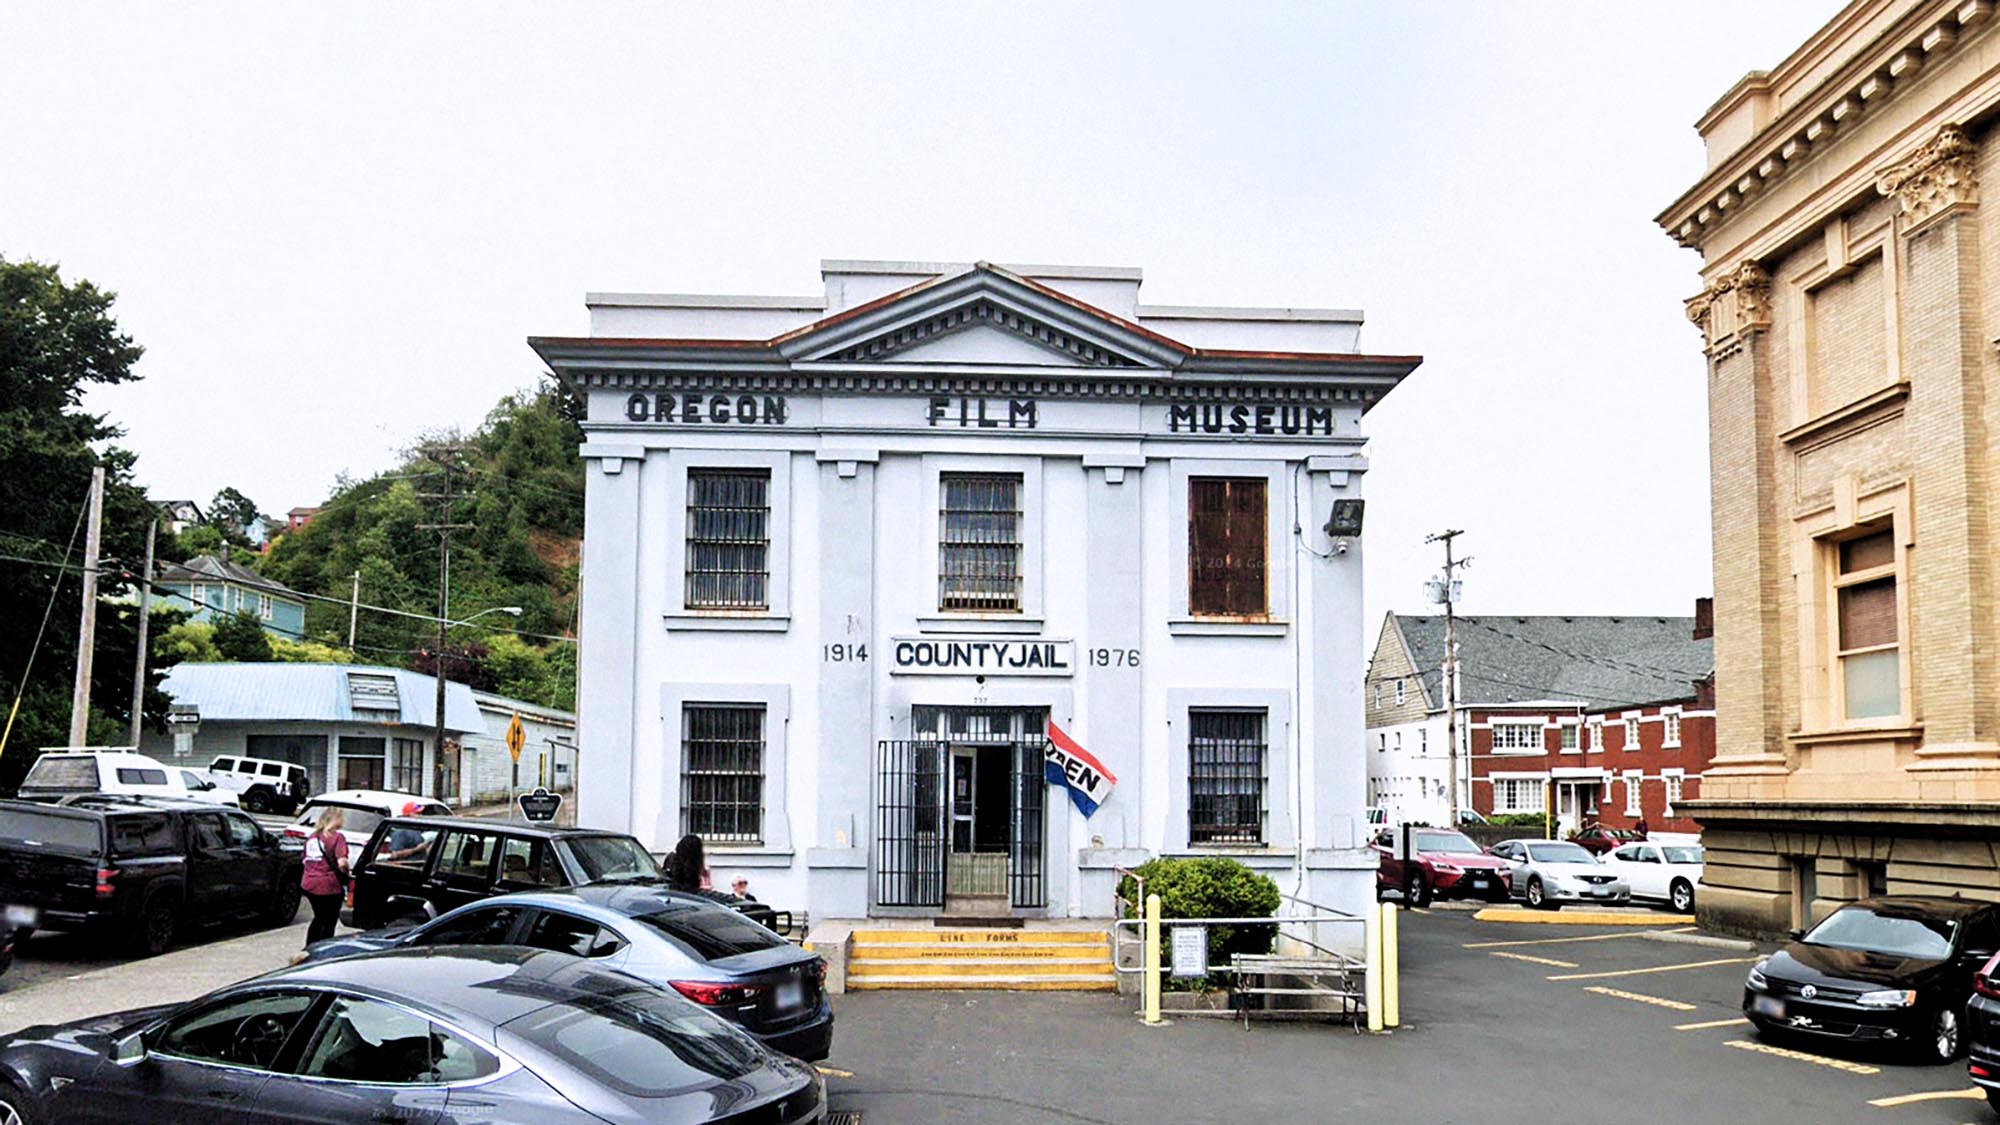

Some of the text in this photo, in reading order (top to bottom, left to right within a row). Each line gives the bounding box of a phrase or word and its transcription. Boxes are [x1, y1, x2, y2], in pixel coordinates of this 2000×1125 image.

[627, 393, 1332, 435] OREGON FILM MUSEUM
[823, 643, 869, 662] 1914
[1088, 648, 1140, 667] 1976
[939, 932, 1019, 943] LINE FORMS
